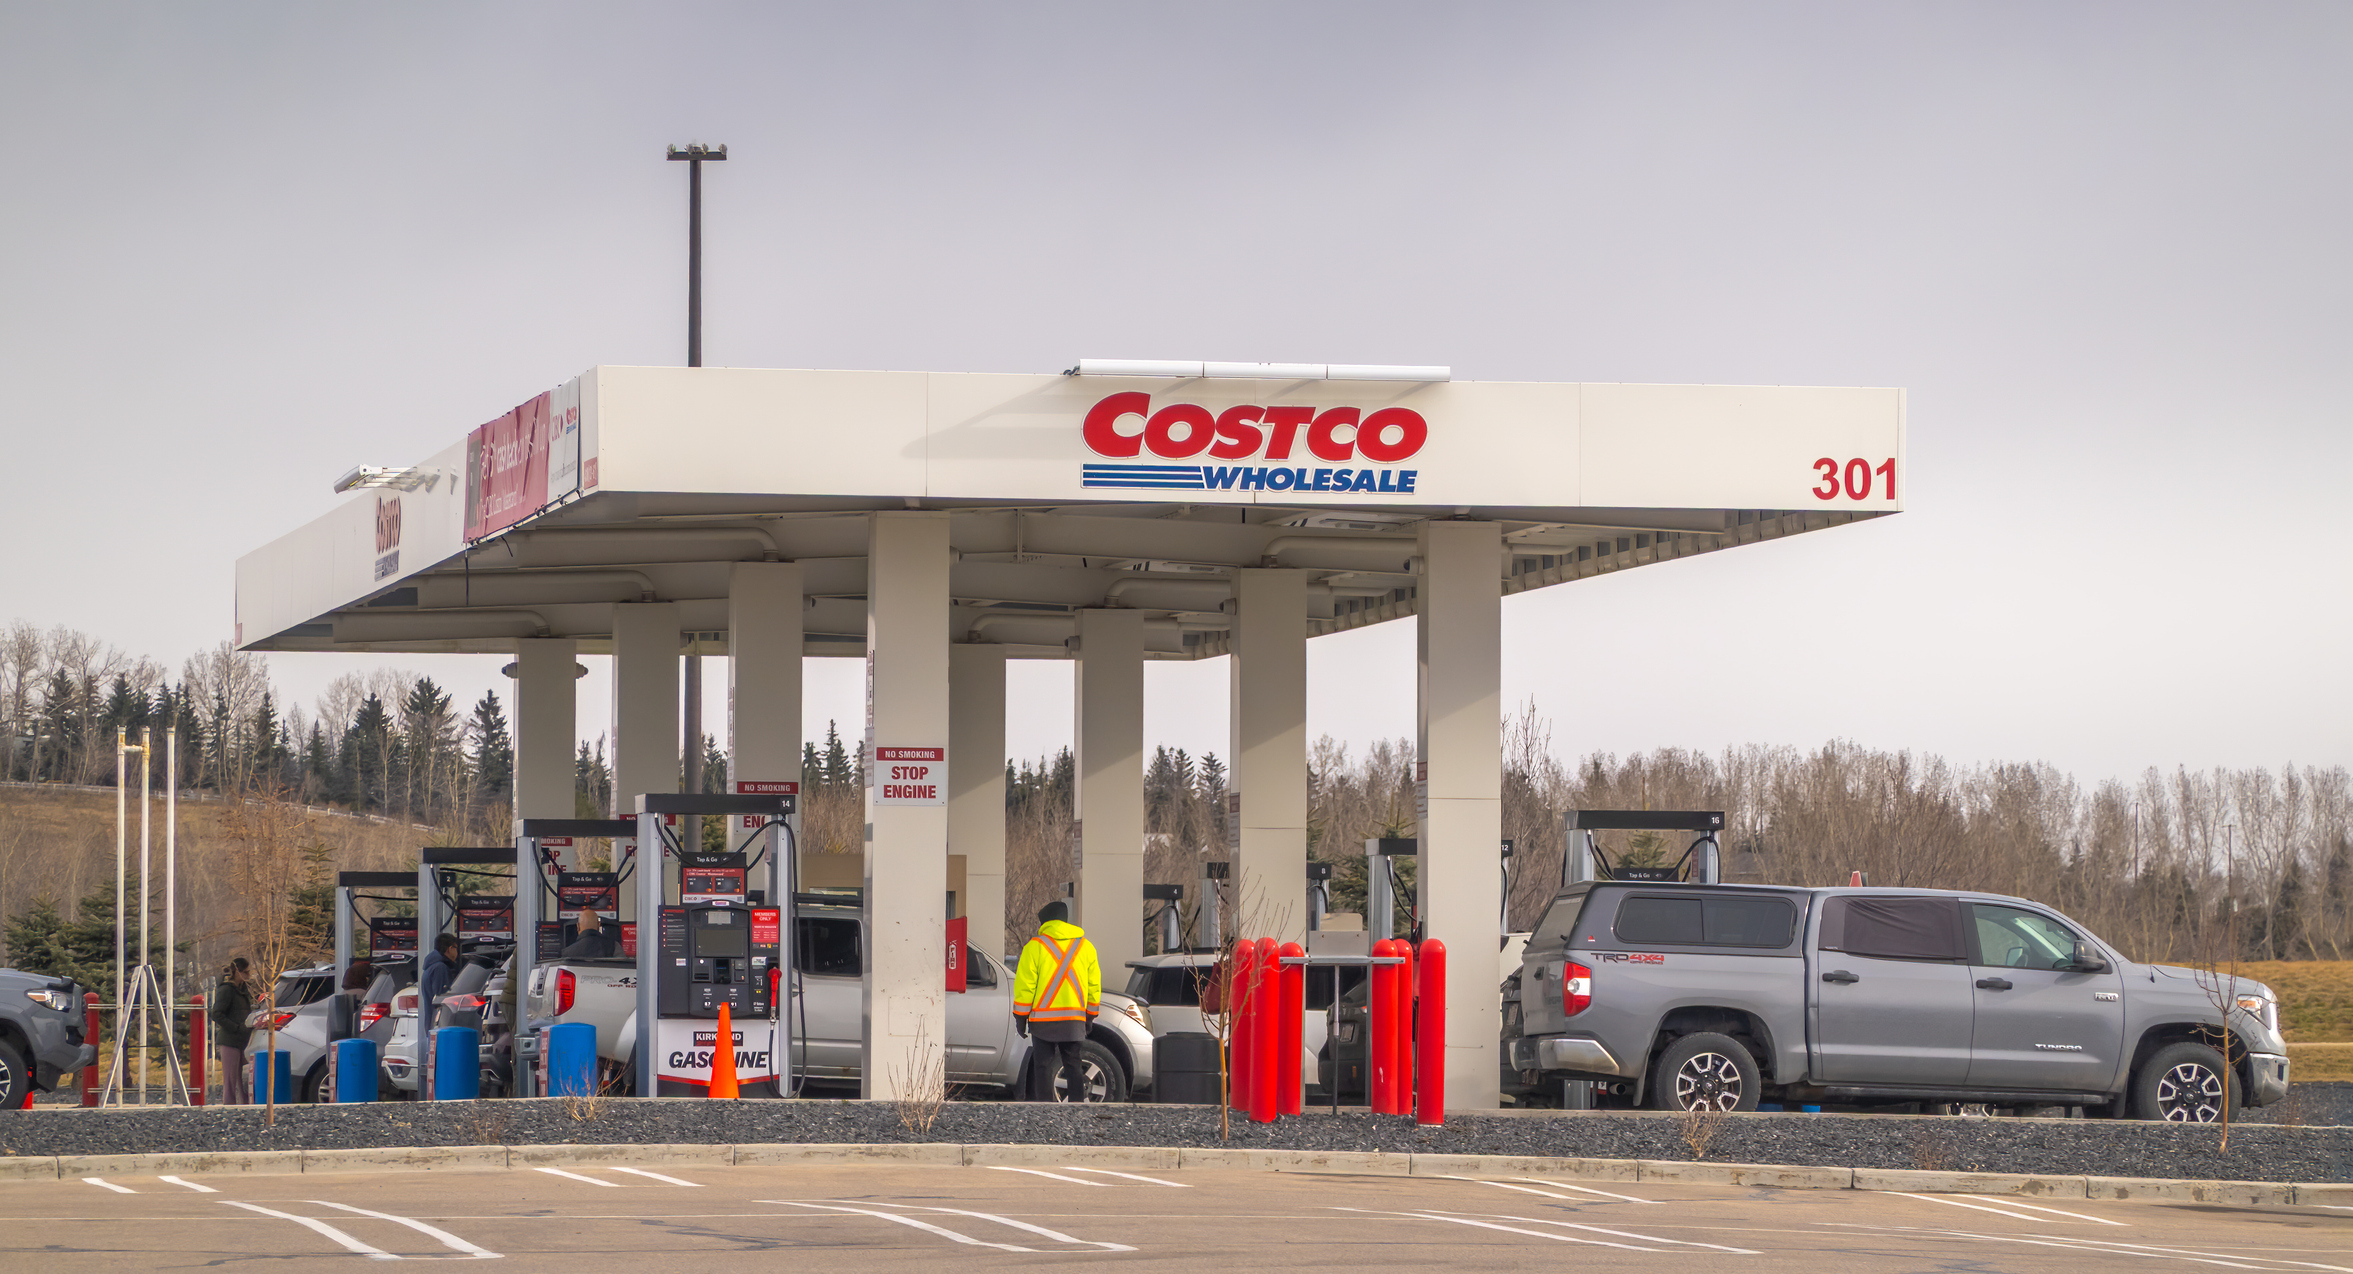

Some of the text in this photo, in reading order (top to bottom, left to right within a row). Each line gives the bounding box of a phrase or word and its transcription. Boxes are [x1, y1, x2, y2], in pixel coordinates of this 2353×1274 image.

[1082, 391, 1428, 463] COSTCO
[1202, 466, 1417, 493] WHOLESALE
[1812, 457, 1896, 501] 301
[885, 750, 935, 759] NO SMOKING
[891, 766, 929, 780] STOP
[757, 784, 791, 792] SMOKING
[883, 784, 937, 799] ENGINE
[1711, 816, 1720, 824] 16
[1590, 952, 1629, 963] TRD
[668, 1051, 769, 1069] GASINE
